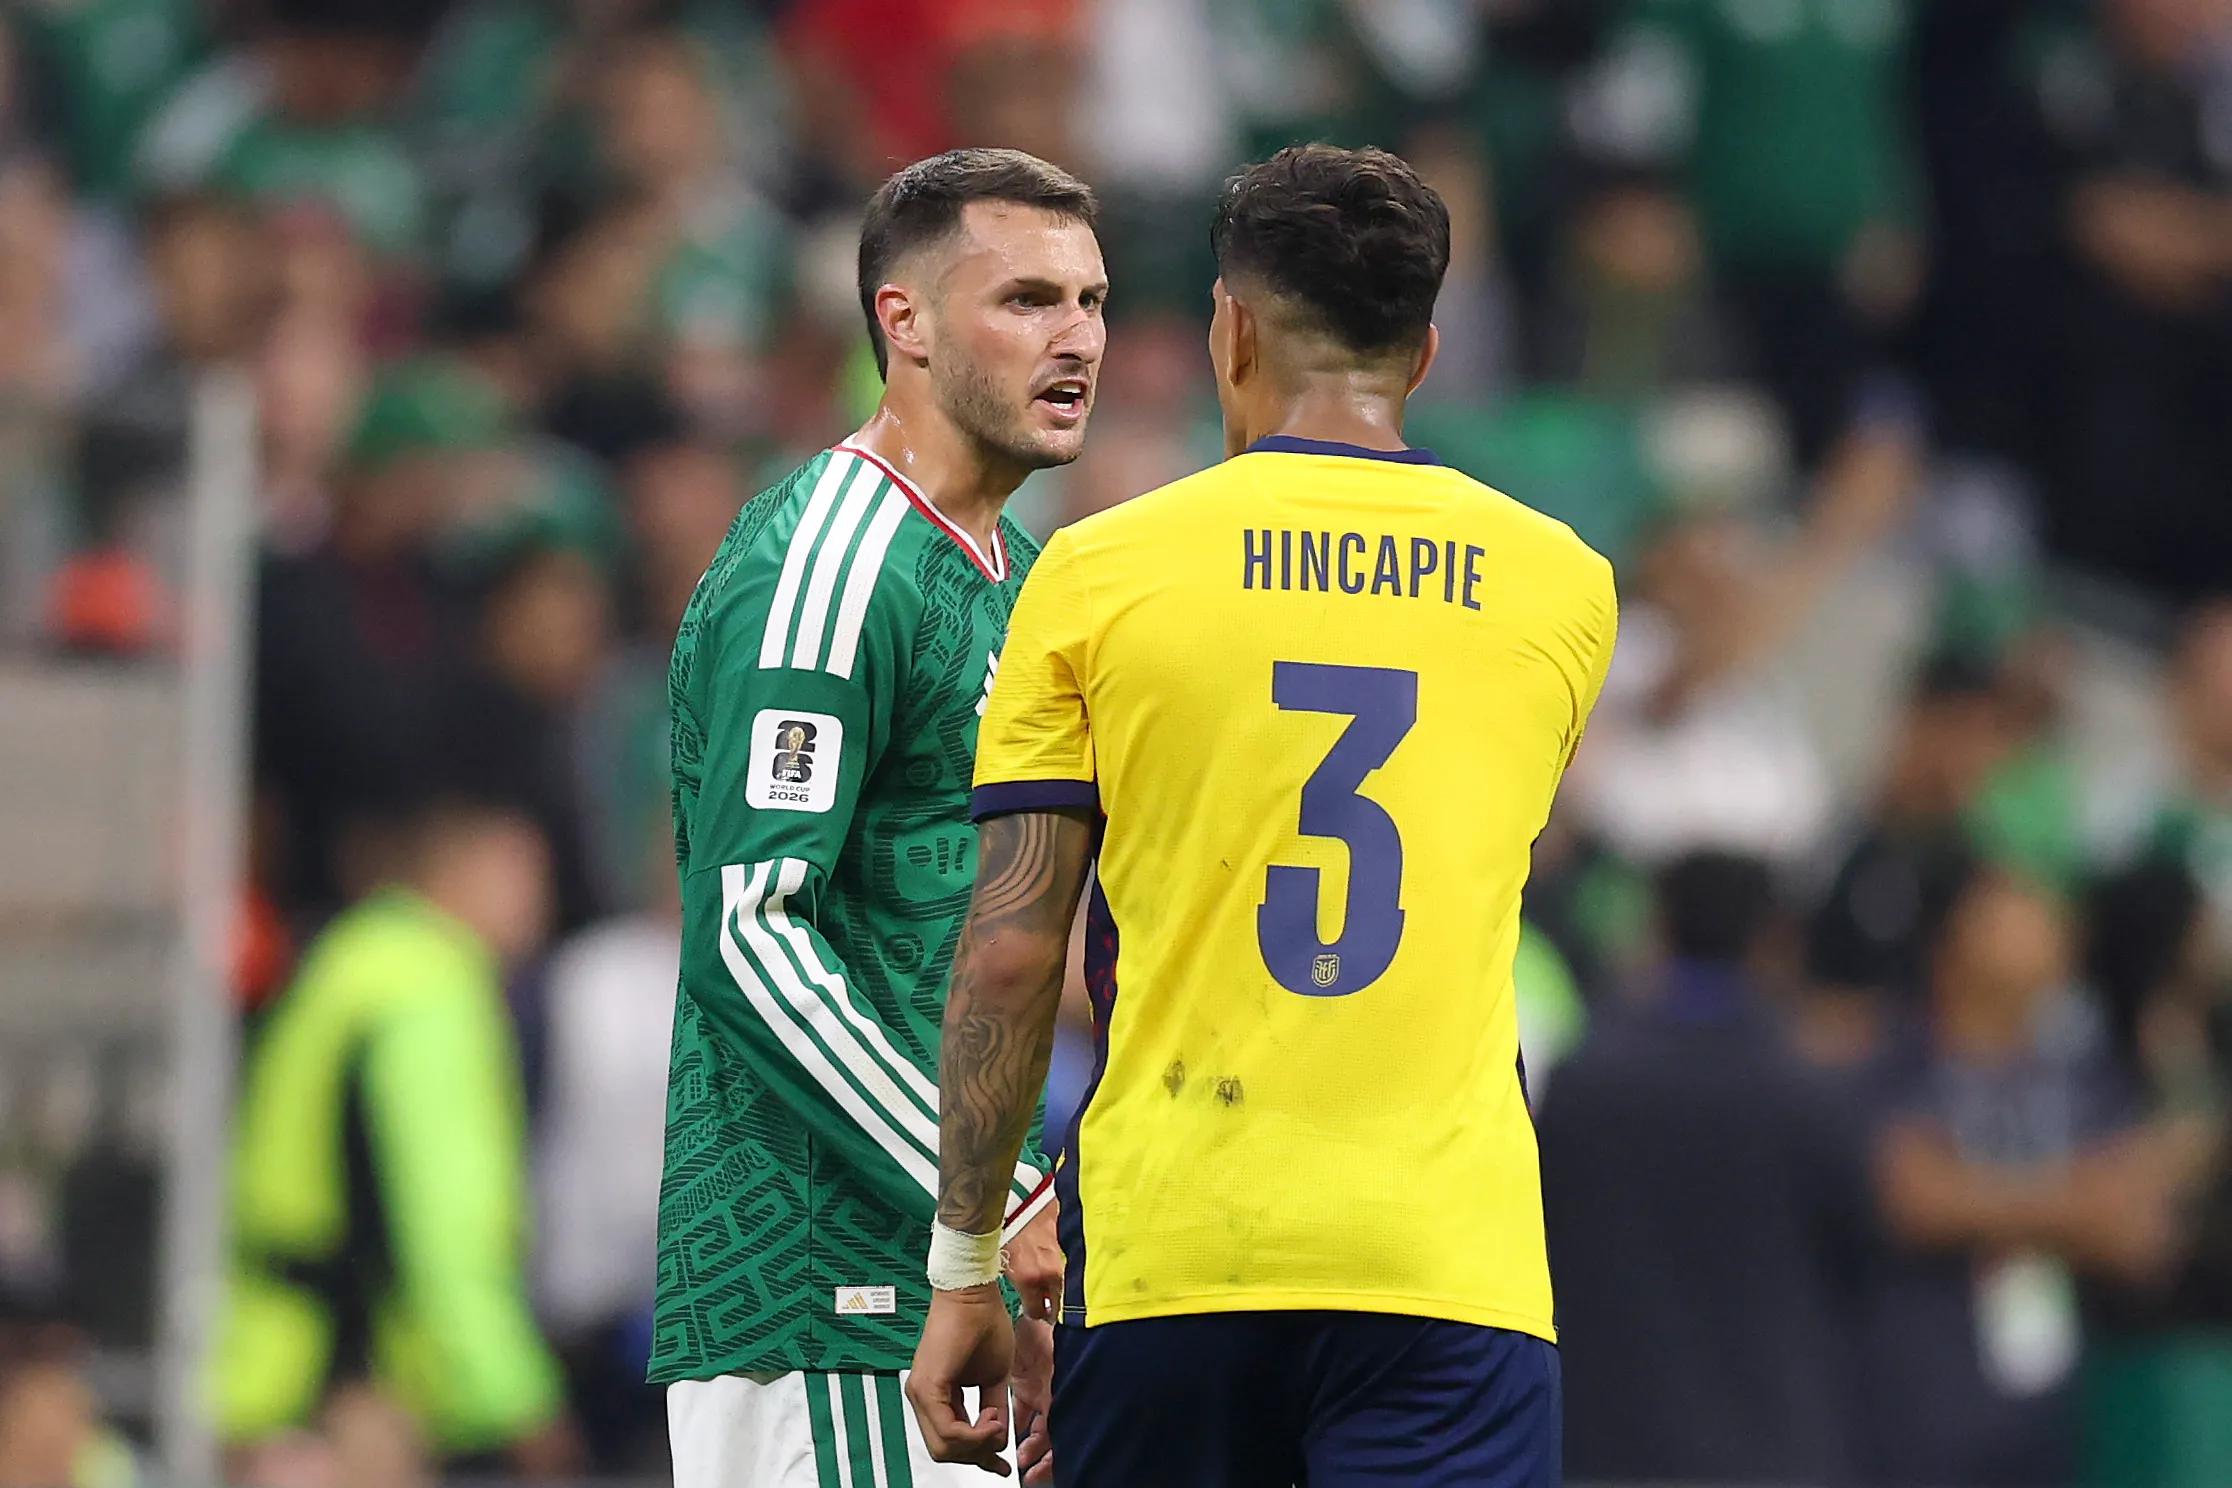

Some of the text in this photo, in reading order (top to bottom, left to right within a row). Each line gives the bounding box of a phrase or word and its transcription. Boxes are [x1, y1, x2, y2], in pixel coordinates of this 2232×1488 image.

[1243, 529, 1485, 611] HINCAPIE
[768, 791, 809, 802] 2026
[1257, 660, 1418, 997] 3
